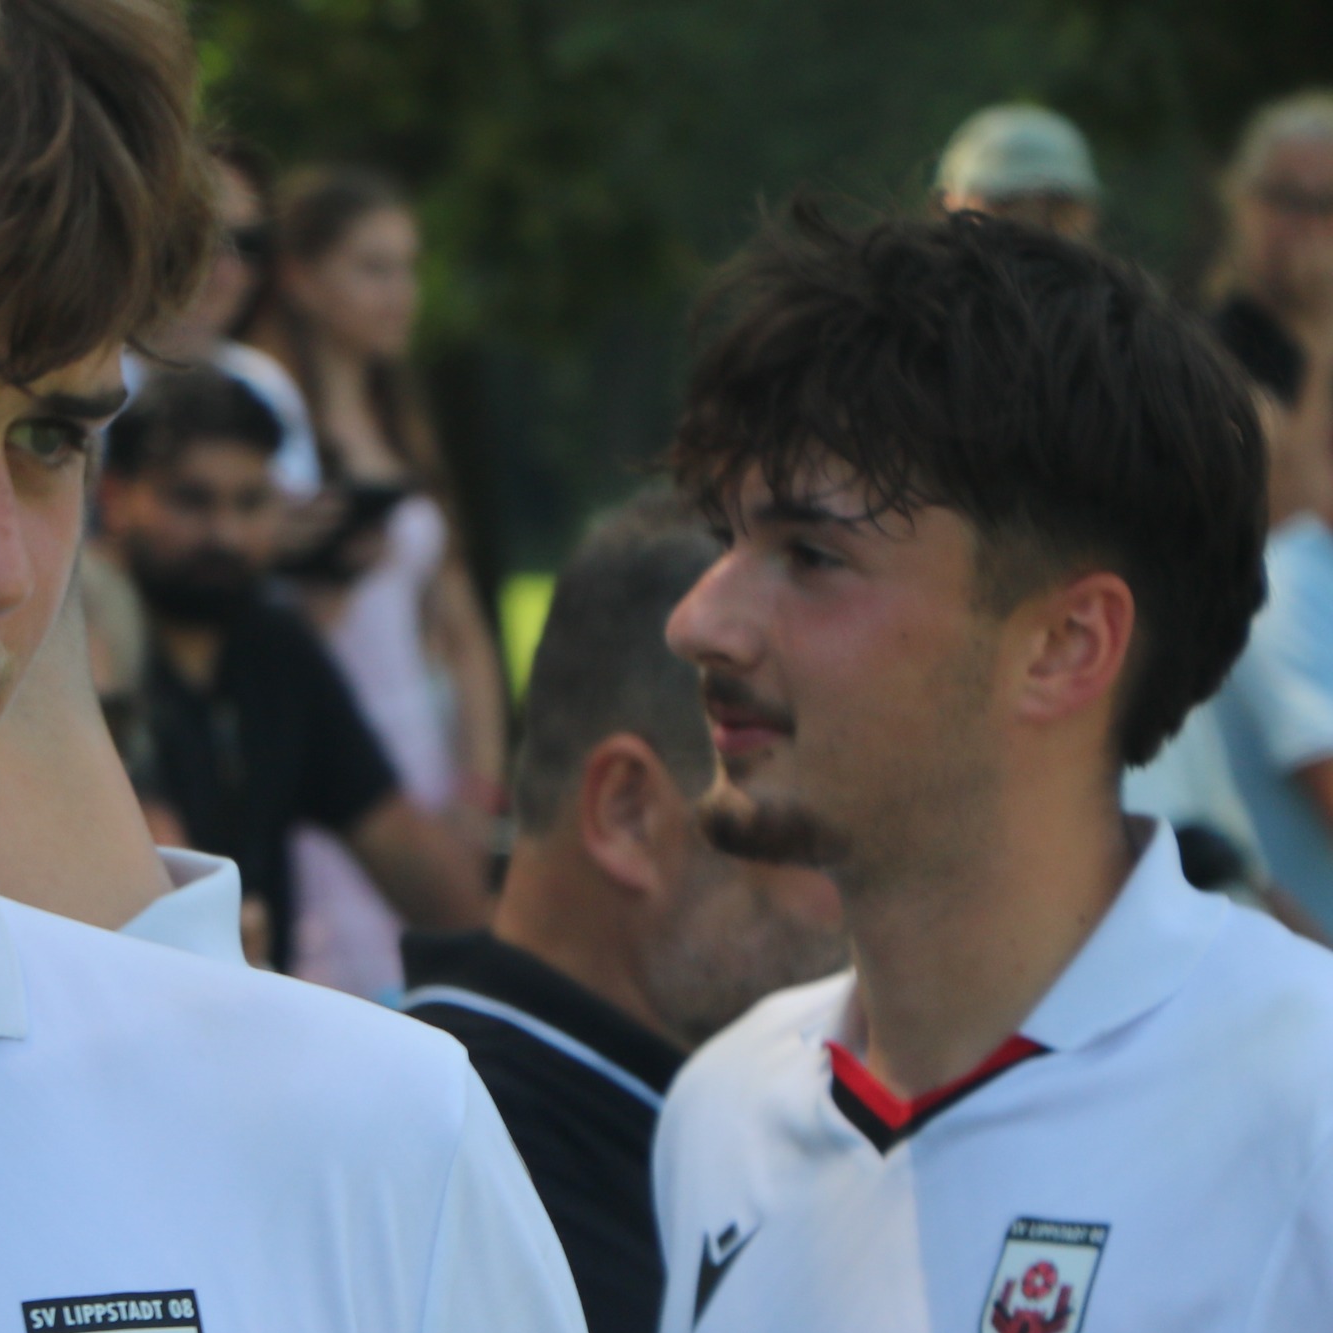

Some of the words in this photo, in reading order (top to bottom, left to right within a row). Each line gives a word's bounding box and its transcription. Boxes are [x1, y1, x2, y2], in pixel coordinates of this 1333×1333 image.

[29, 1306, 57, 1330] SV
[62, 1299, 163, 1327] LIPPSTADT
[168, 1297, 195, 1319] 08
